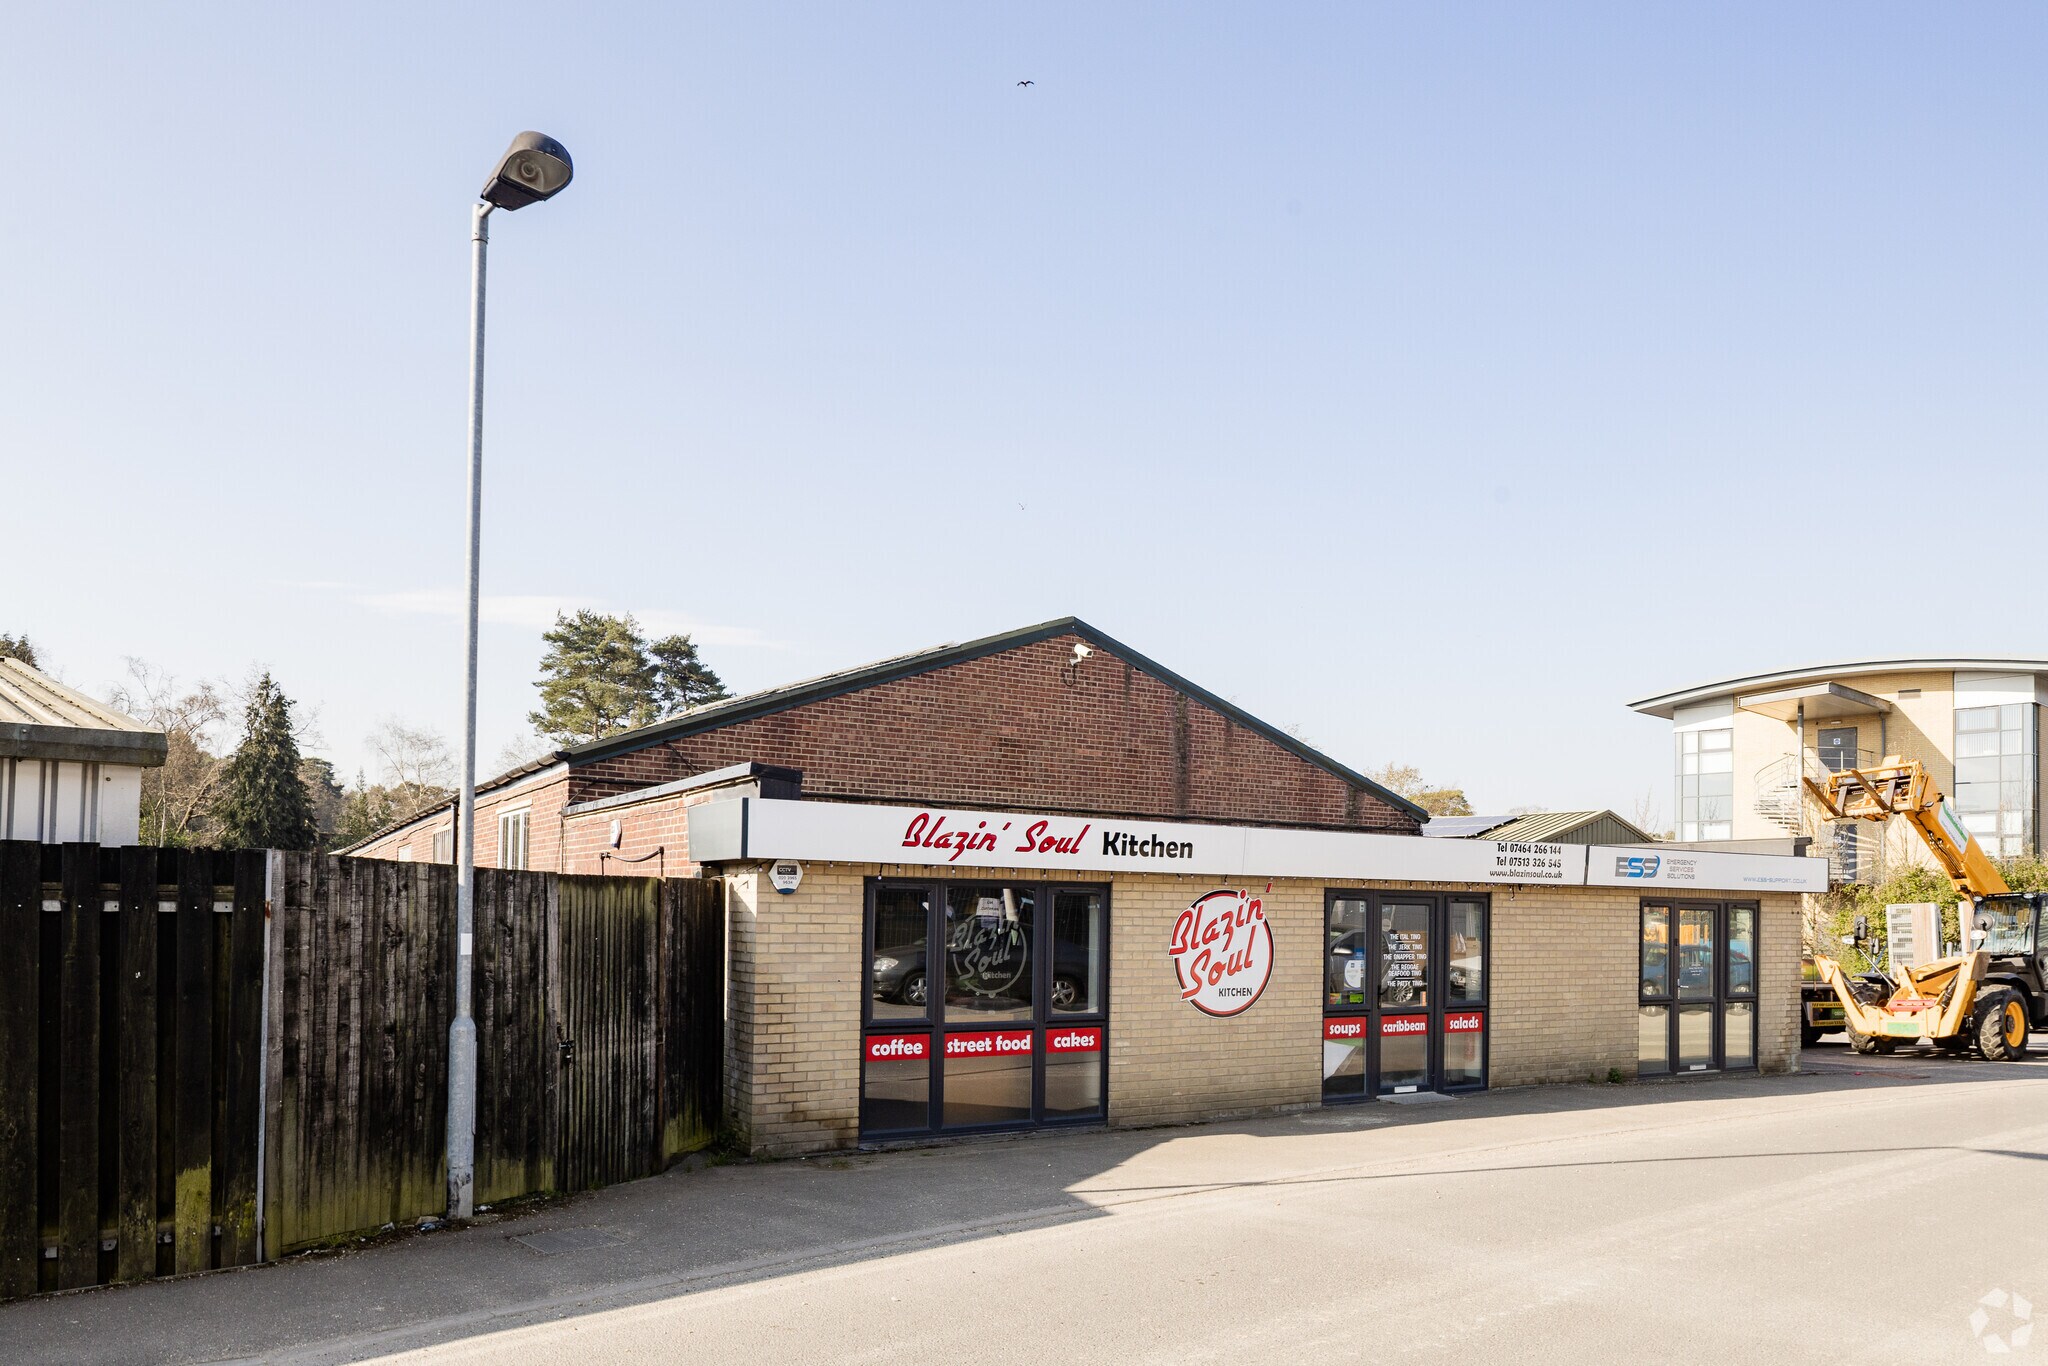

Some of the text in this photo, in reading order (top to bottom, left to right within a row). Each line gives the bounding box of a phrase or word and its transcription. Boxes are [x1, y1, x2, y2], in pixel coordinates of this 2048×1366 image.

[902, 812, 1193, 862] Blazin' Soul Kitchen
[1497, 843, 1561, 854] Tel 07464 266 144
[1496, 856, 1561, 868] Tel 07513 326 545
[1490, 869, 1562, 878] www.blazinsoul.co.uk
[960, 932, 1011, 980] Soul
[1181, 925, 1256, 999] Soul
[982, 971, 1011, 979] Kitchen
[1219, 988, 1252, 996] KITCHEN
[1382, 1020, 1426, 1032] caribbean
[1450, 1016, 1478, 1029] salads
[1329, 1023, 1361, 1036] soups
[947, 1034, 1031, 1053] street food
[1054, 1032, 1095, 1048] cakes
[871, 1039, 923, 1056] coffee
